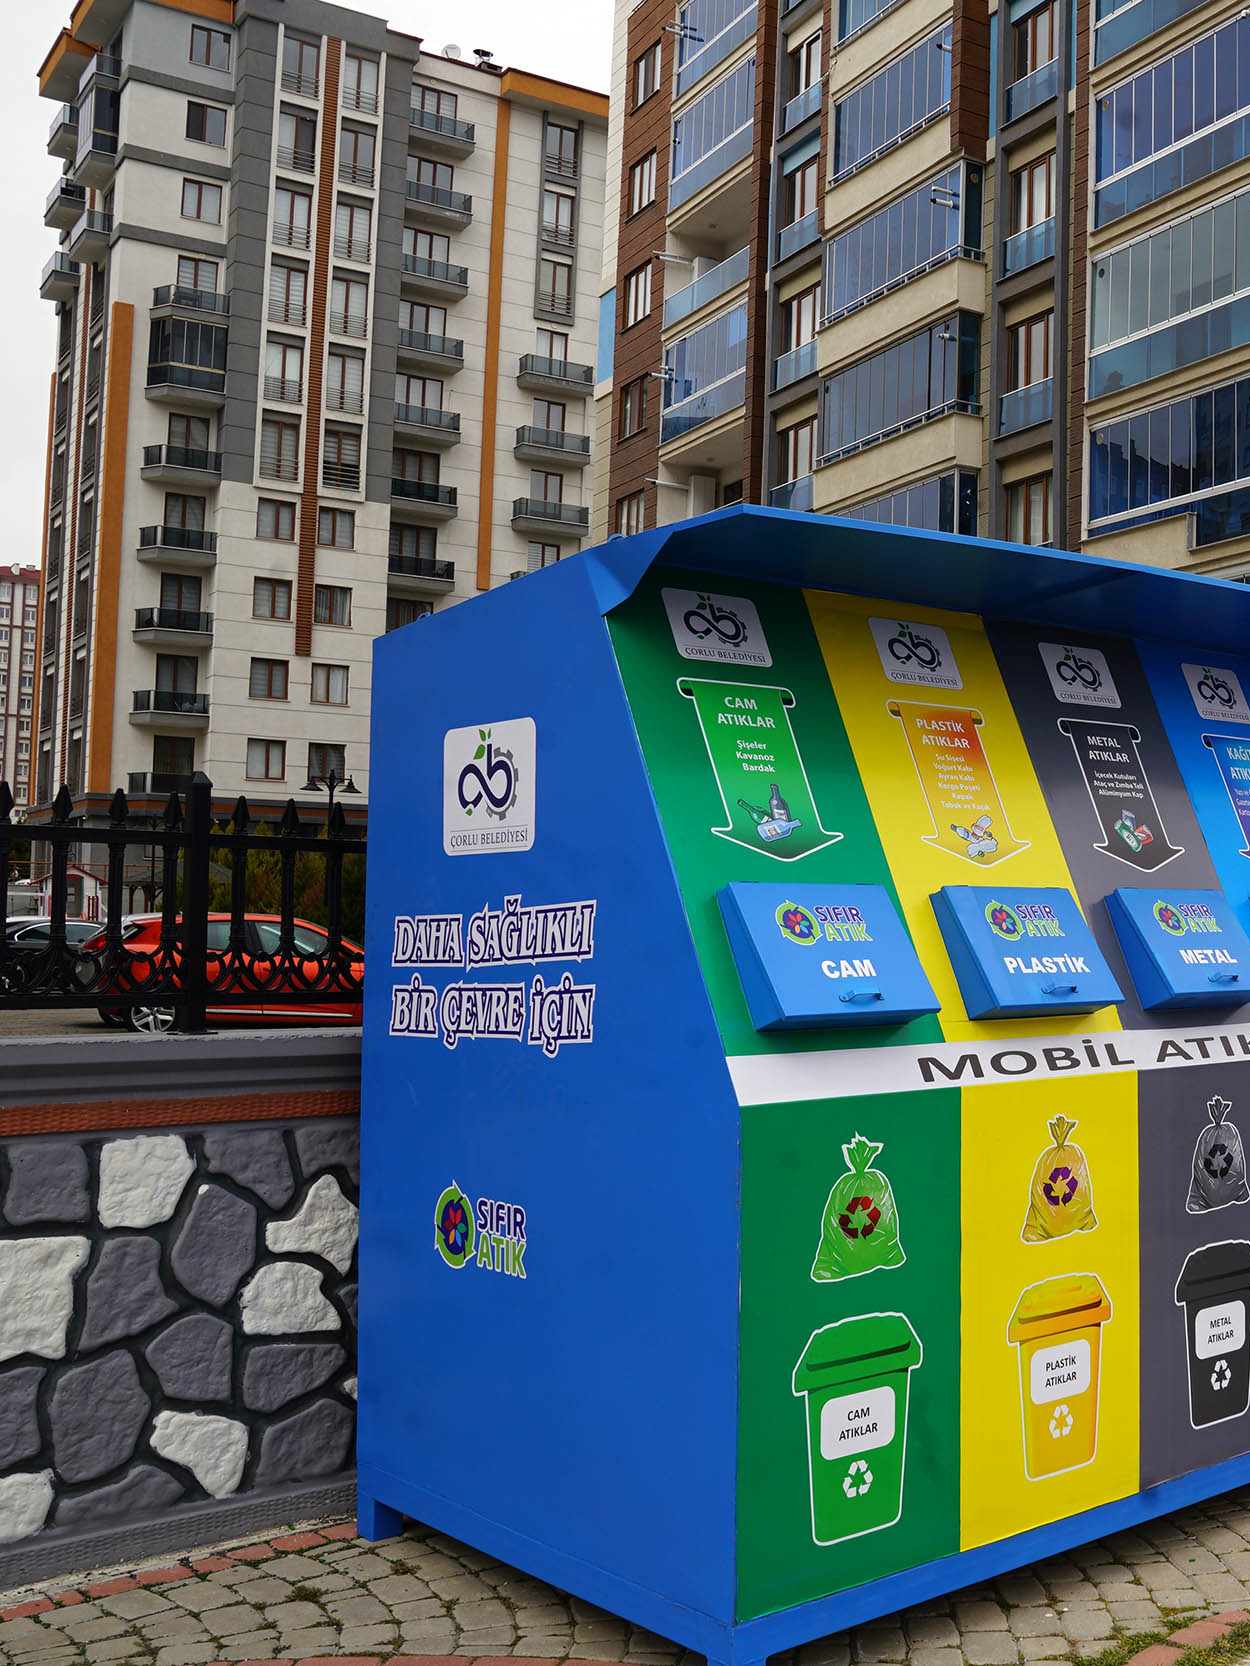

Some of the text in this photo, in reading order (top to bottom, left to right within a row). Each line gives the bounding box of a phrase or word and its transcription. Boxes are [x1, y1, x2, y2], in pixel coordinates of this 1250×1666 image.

[685, 647, 766, 663] ÇORLU BELEDİYESİ
[724, 697, 758, 710] CAM
[717, 713, 776, 728] ATIKLAR
[916, 718, 965, 733] PLASTİK
[736, 740, 767, 750] Şişeler
[922, 735, 970, 749] ATIKLAR
[1087, 735, 1120, 748] METAL
[735, 751, 775, 761] Kavanoz
[1089, 750, 1130, 763] ATIKLAR
[742, 763, 776, 772] Bardak
[450, 828, 528, 849] ÇORLU BELEDİYESİ
[814, 906, 864, 923] SIFIR
[1015, 904, 1056, 920] SIFIR
[1178, 904, 1213, 918] SIFIR
[392, 894, 597, 971] DAHA SAĞLIKLI
[824, 923, 873, 942] ATIK
[1025, 920, 1066, 937] ATIK
[1188, 917, 1223, 933] ATIK
[1003, 952, 1091, 974] PLASTİK
[1179, 949, 1239, 964] METAL
[821, 959, 877, 979] CAM
[390, 971, 596, 1059] BİR ÇEVRE İÇİN
[917, 1038, 1135, 1083] MOBİL
[477, 1197, 527, 1241] SIFIR
[477, 1232, 527, 1279] ATIK
[1209, 1316, 1232, 1330] METAL
[1207, 1329, 1234, 1344] ATIKLAR
[1045, 1354, 1077, 1372] PLASTİK
[1045, 1371, 1077, 1388] ATIKLAR
[847, 1406, 870, 1422] CAM
[839, 1422, 878, 1441] ATIKLAR
